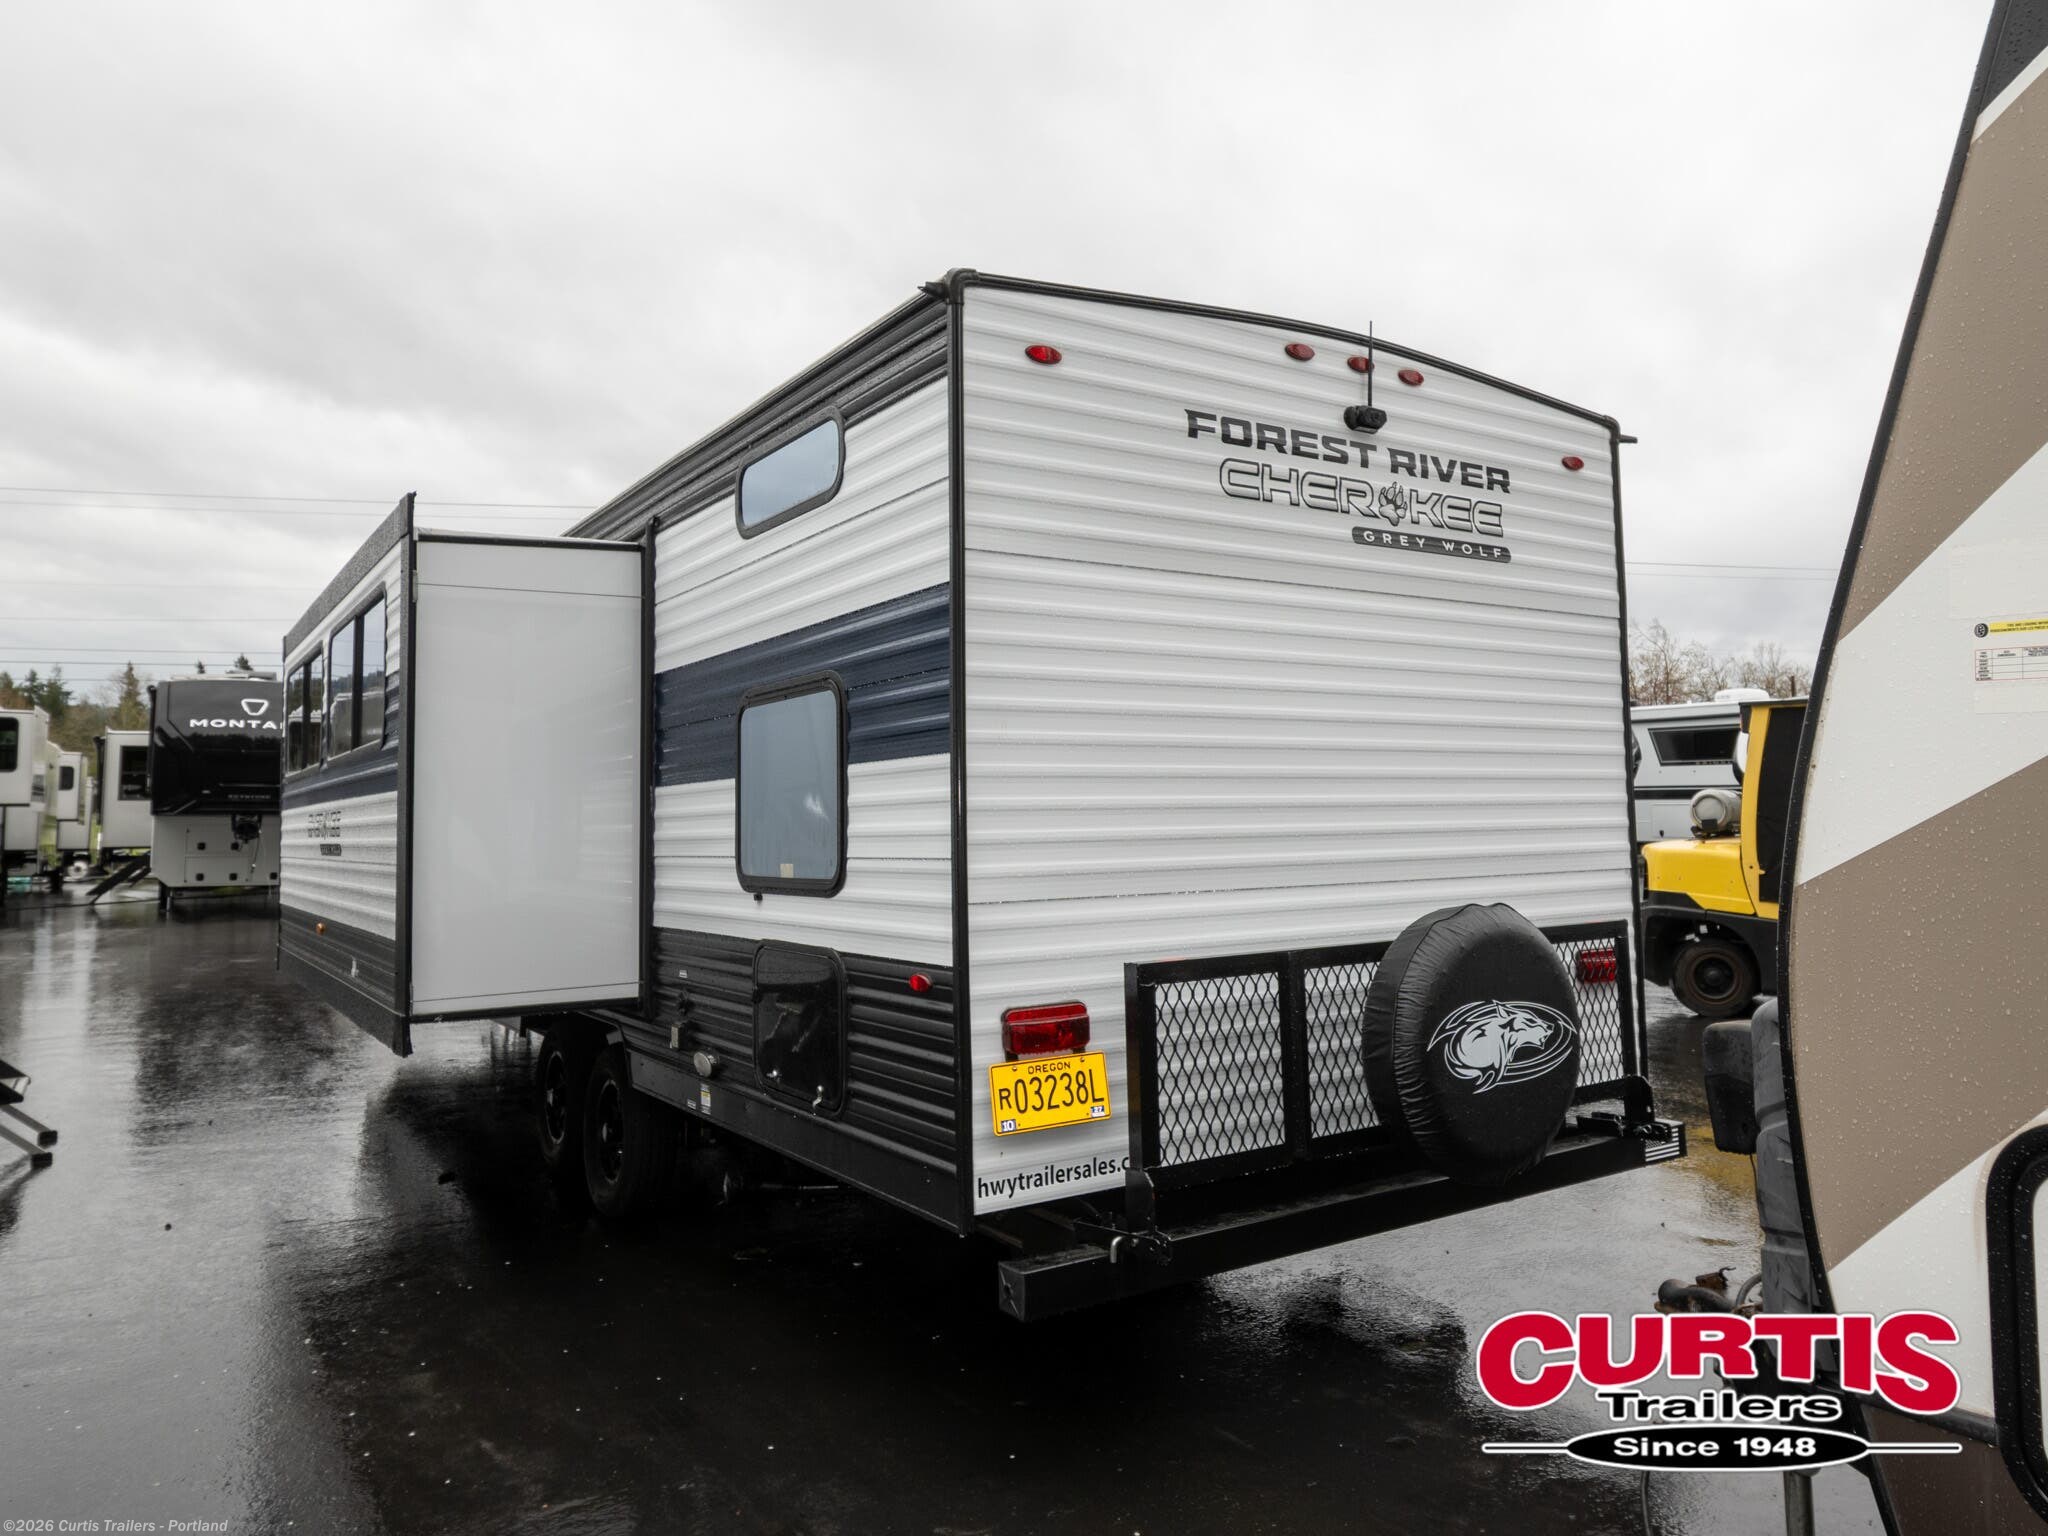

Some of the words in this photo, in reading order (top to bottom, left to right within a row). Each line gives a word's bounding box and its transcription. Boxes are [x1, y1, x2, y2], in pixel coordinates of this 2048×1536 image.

[1184, 408, 1377, 468] FOREST
[1386, 447, 1511, 493] RIVER
[1363, 530, 1426, 549] GREY
[1443, 540, 1503, 559] WOLF
[189, 719, 283, 730] MONTA
[1027, 1061, 1071, 1075] OREGON
[998, 1069, 1105, 1114] R03238L
[1002, 1120, 1015, 1131] 10
